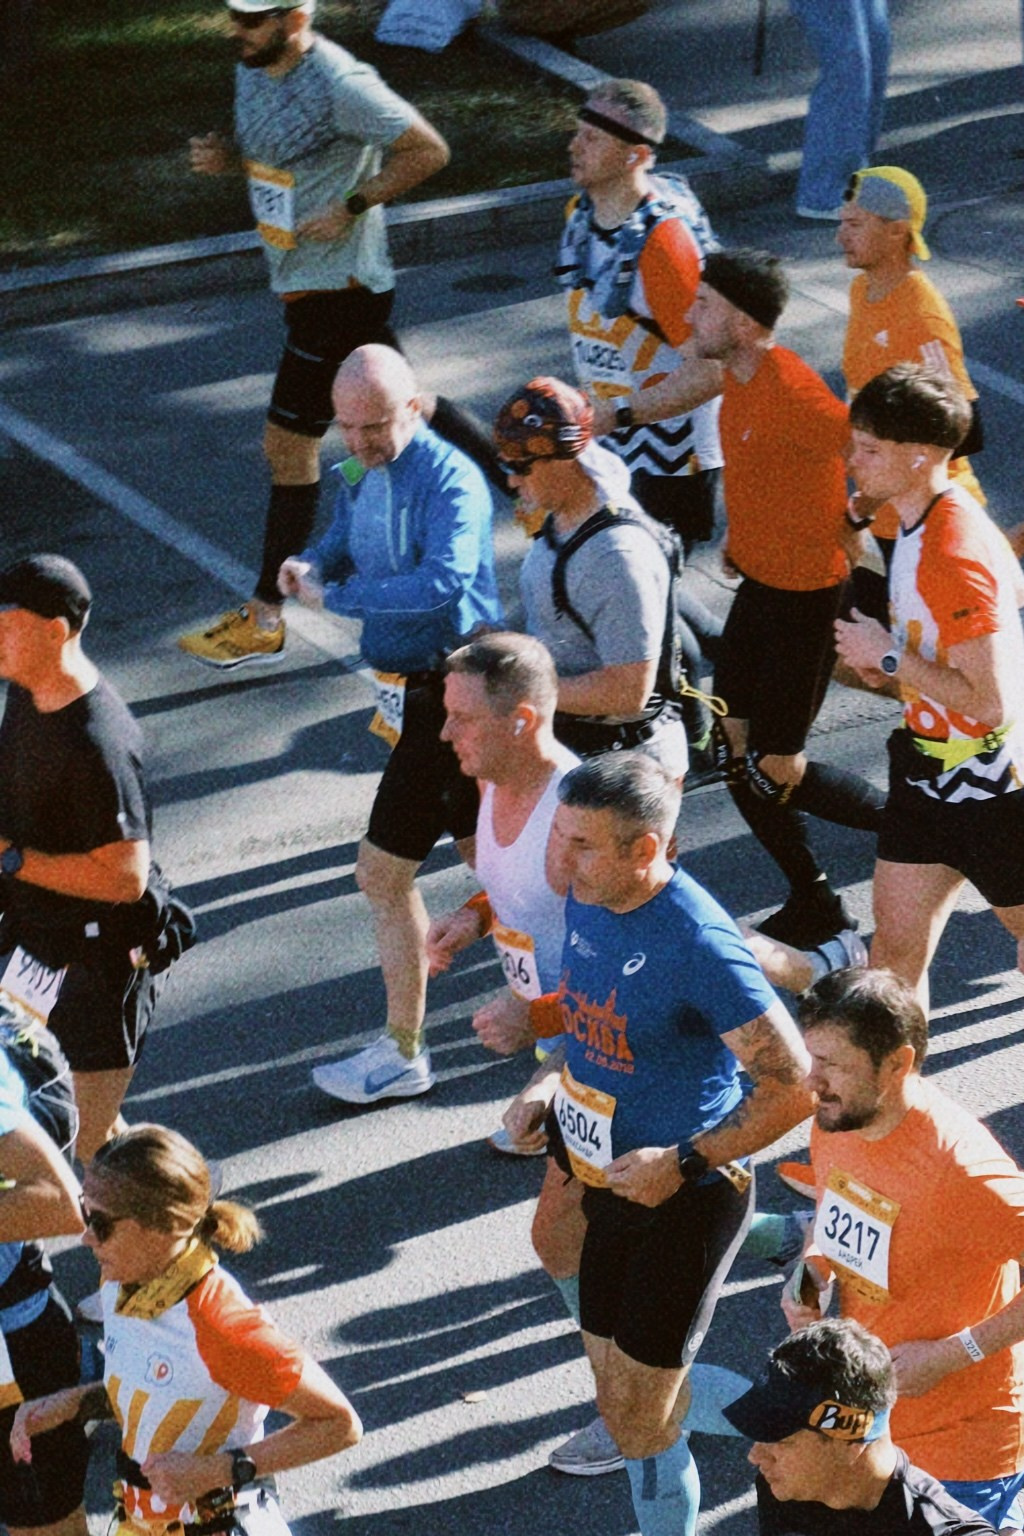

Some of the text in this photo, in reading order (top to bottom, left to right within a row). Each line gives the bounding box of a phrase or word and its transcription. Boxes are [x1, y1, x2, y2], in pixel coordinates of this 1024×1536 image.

[559, 1098, 602, 1152] 6504
[824, 1204, 881, 1261] 3217
[964, 1339, 981, 1358] 3217
